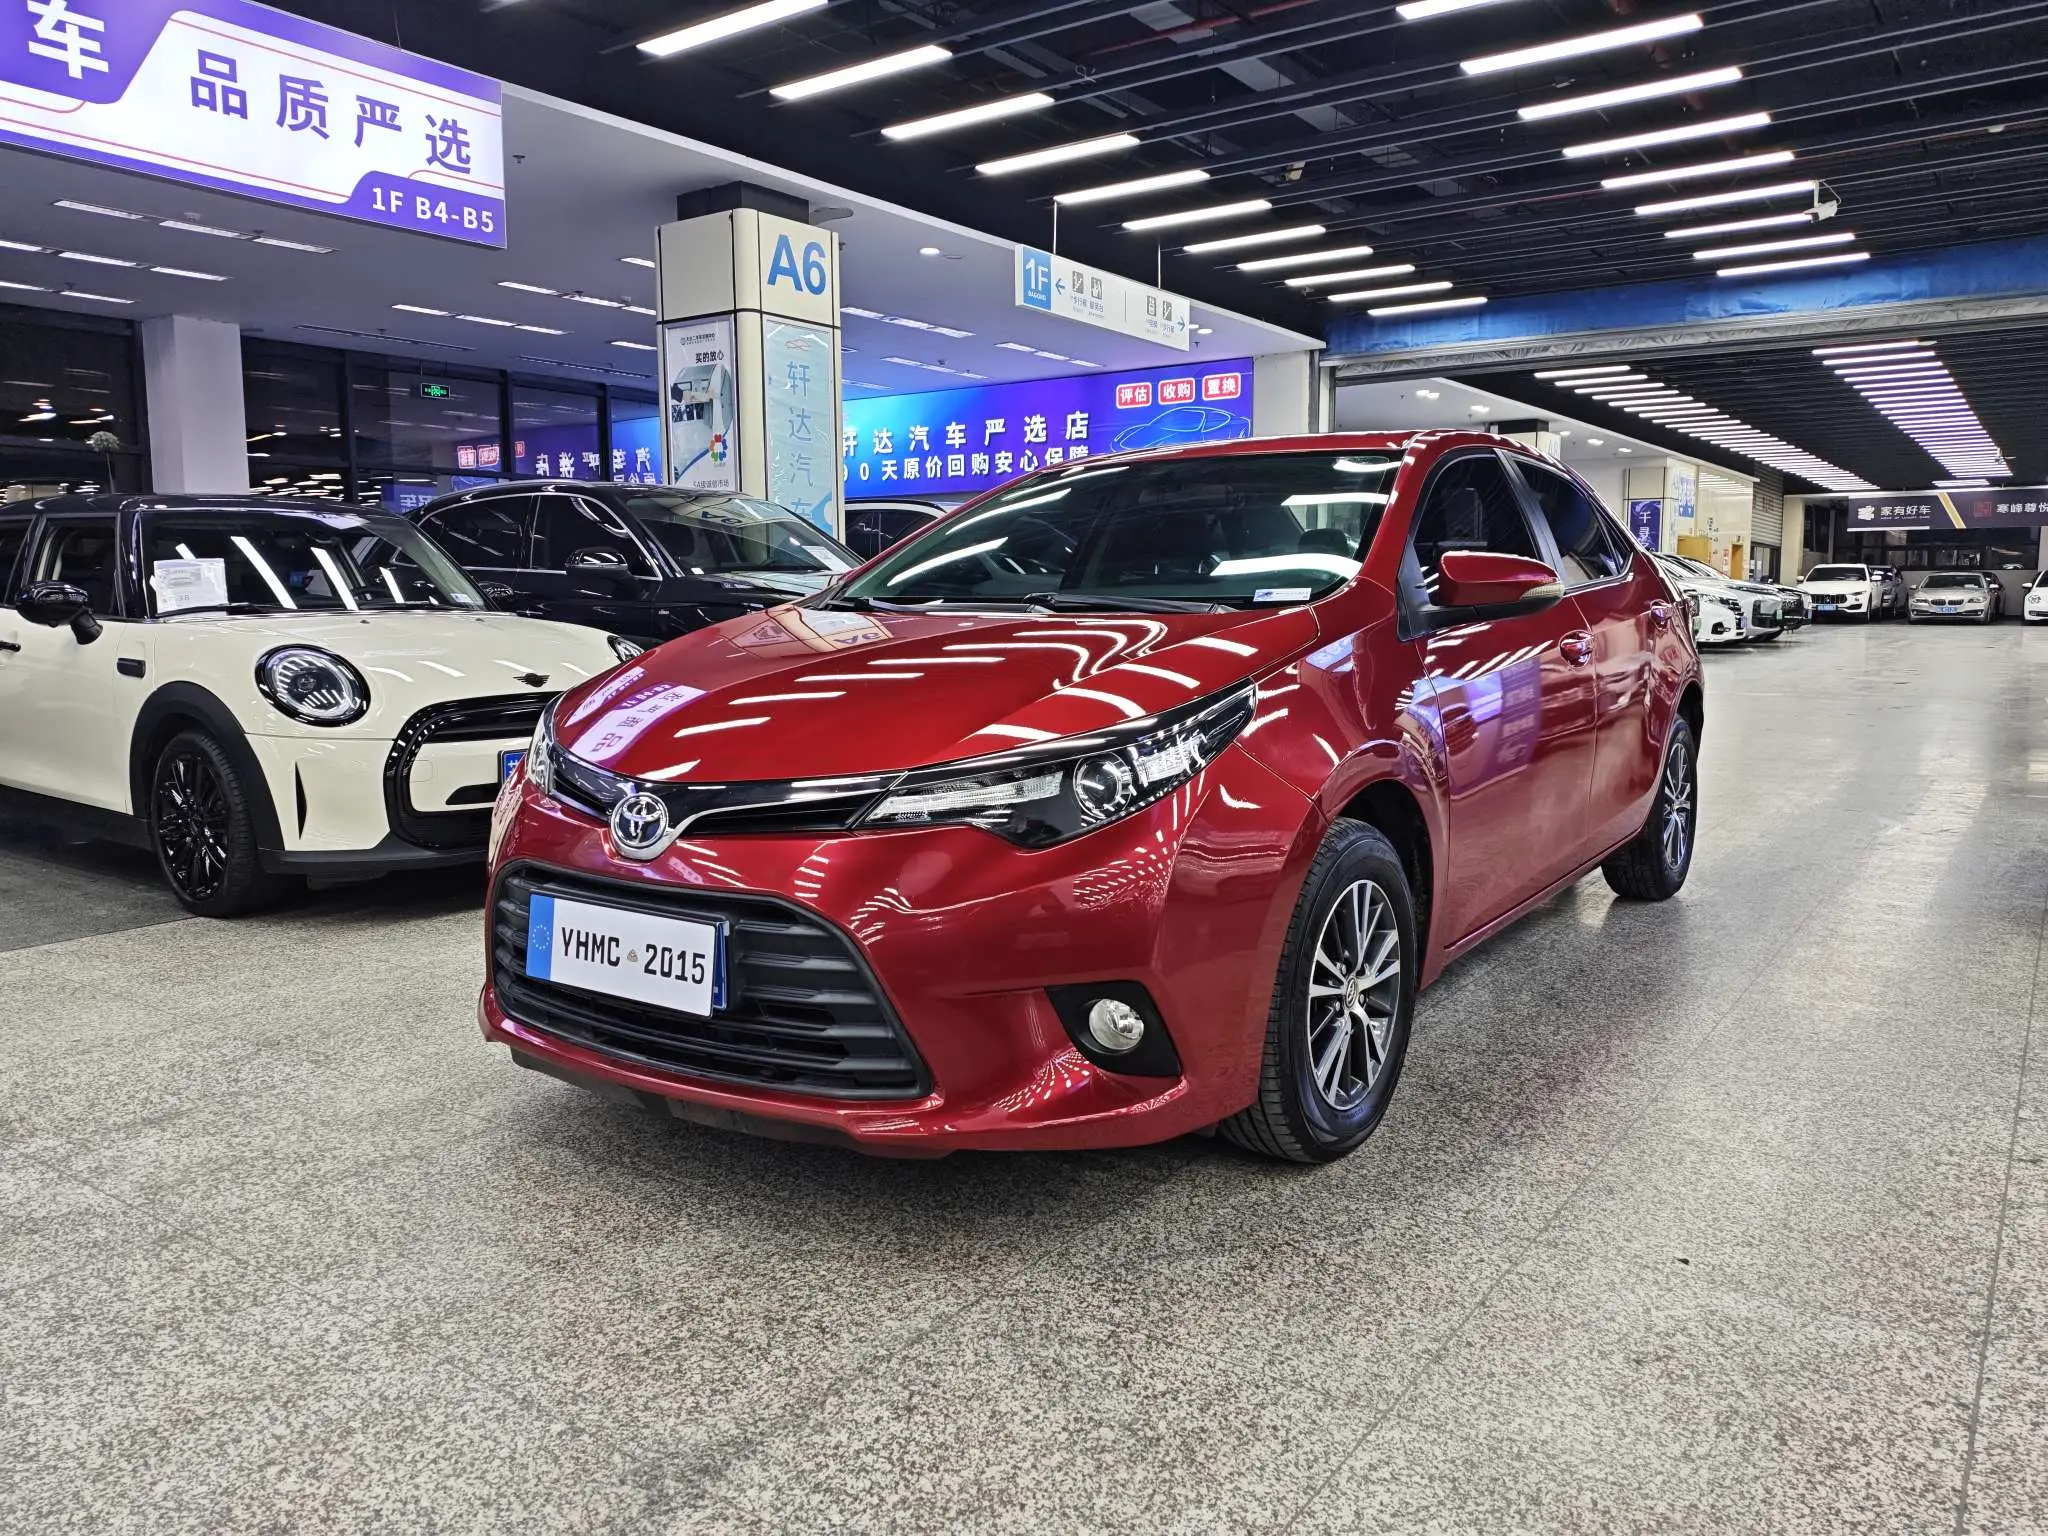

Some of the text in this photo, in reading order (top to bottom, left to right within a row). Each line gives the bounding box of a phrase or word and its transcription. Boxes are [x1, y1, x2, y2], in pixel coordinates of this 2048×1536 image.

[27, 0, 109, 79] 车
[190, 48, 471, 174] 品质严选
[372, 187, 495, 233] 1F B4-B5
[767, 234, 827, 295] A6
[1026, 258, 1049, 291] 1F
[695, 350, 725, 364] 买的放心
[1119, 377, 1237, 404] 评估 收购 置换
[1880, 504, 1932, 516] 家有好车
[561, 926, 706, 985] YHMC 2015
